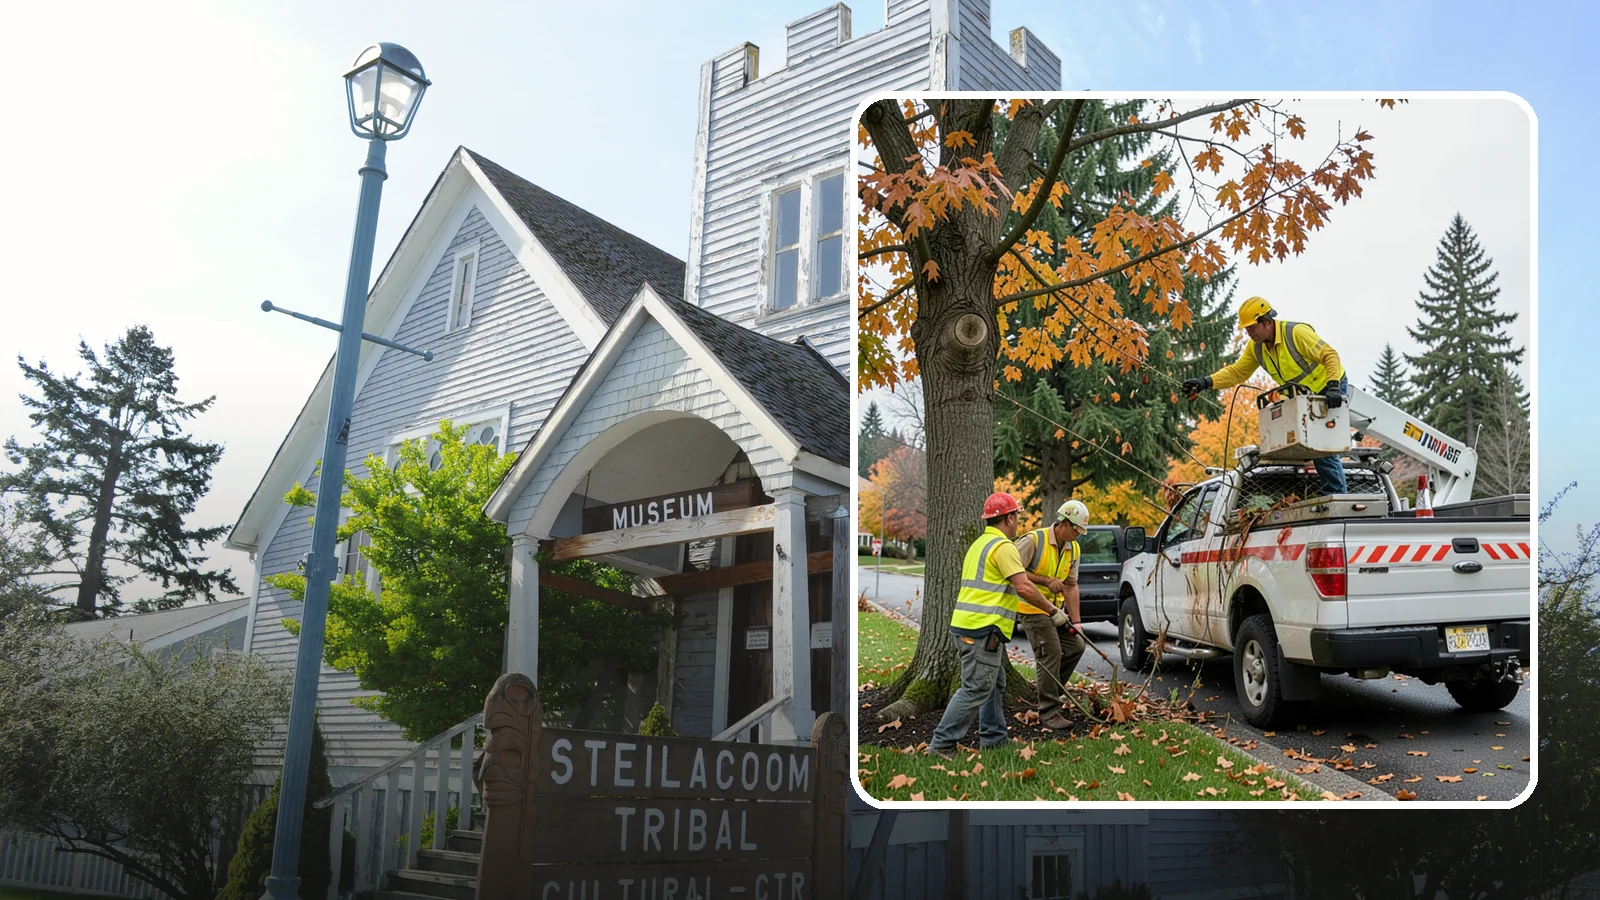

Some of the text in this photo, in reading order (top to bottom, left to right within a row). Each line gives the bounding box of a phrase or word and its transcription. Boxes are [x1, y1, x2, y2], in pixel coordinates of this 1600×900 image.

[613, 491, 713, 530] MUSEUM
[551, 738, 810, 792] STEILACOOM
[615, 807, 758, 852] TRIBAL
